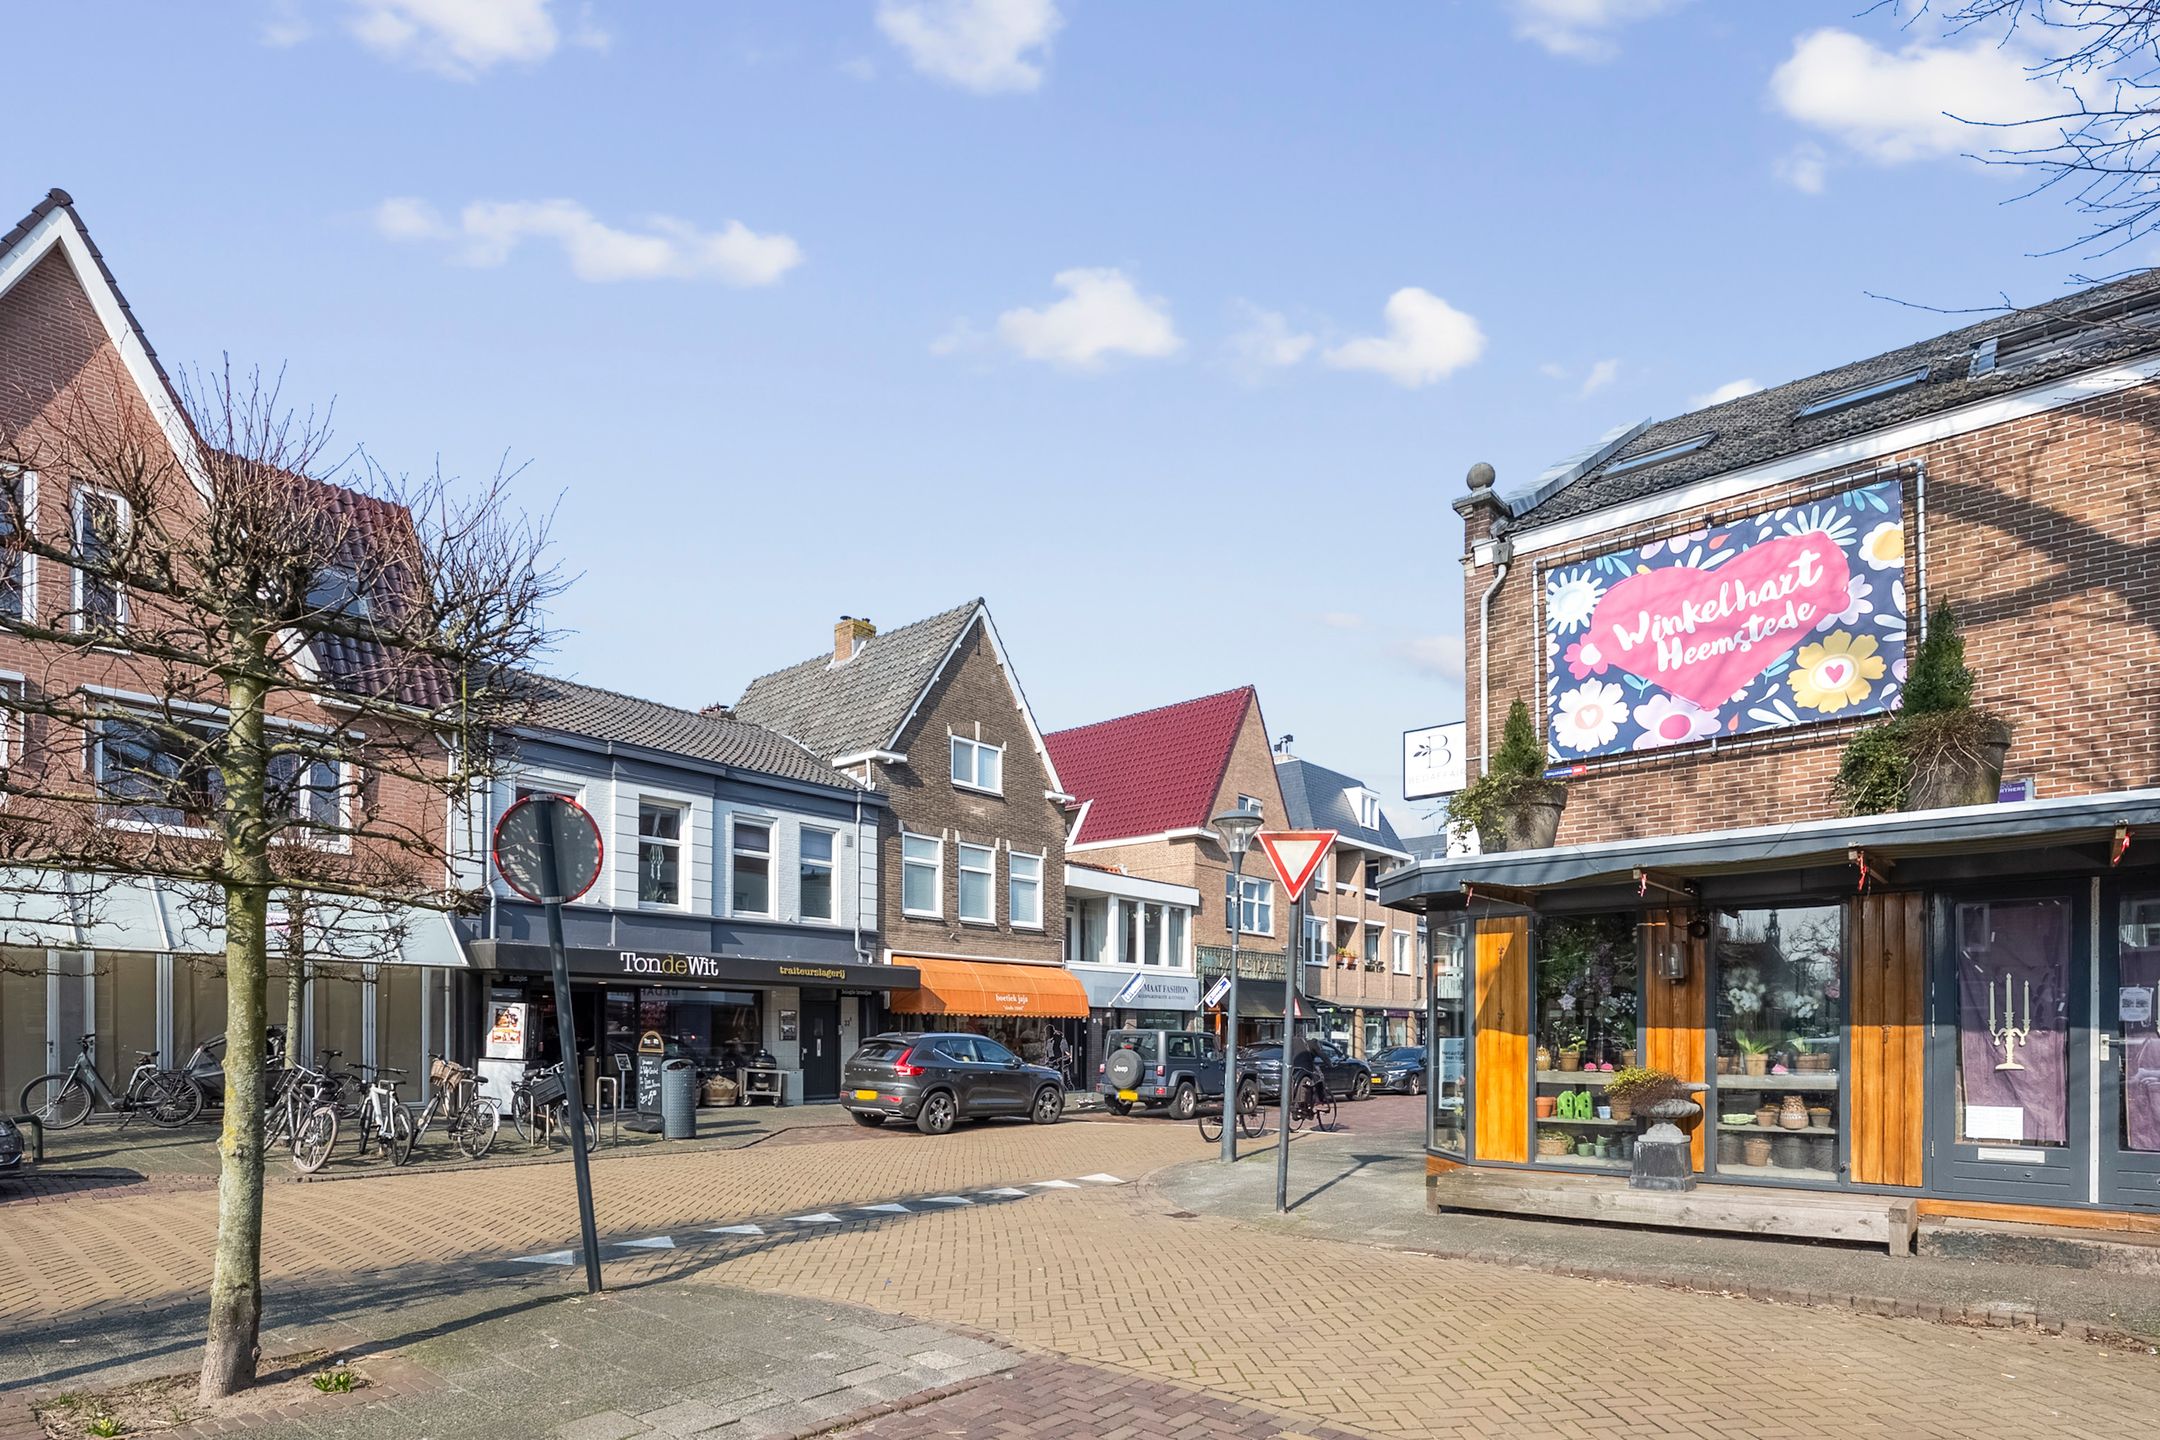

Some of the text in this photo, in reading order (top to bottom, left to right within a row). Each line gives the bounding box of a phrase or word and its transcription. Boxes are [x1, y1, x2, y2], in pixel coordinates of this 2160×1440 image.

[1613, 550, 1823, 651] Winkelhart
[1657, 600, 1816, 672] Heemstede
[780, 966, 846, 979] traiteurslagerij
[1162, 984, 1189, 994] FASHION
[1113, 1064, 1129, 1073] Jeep
